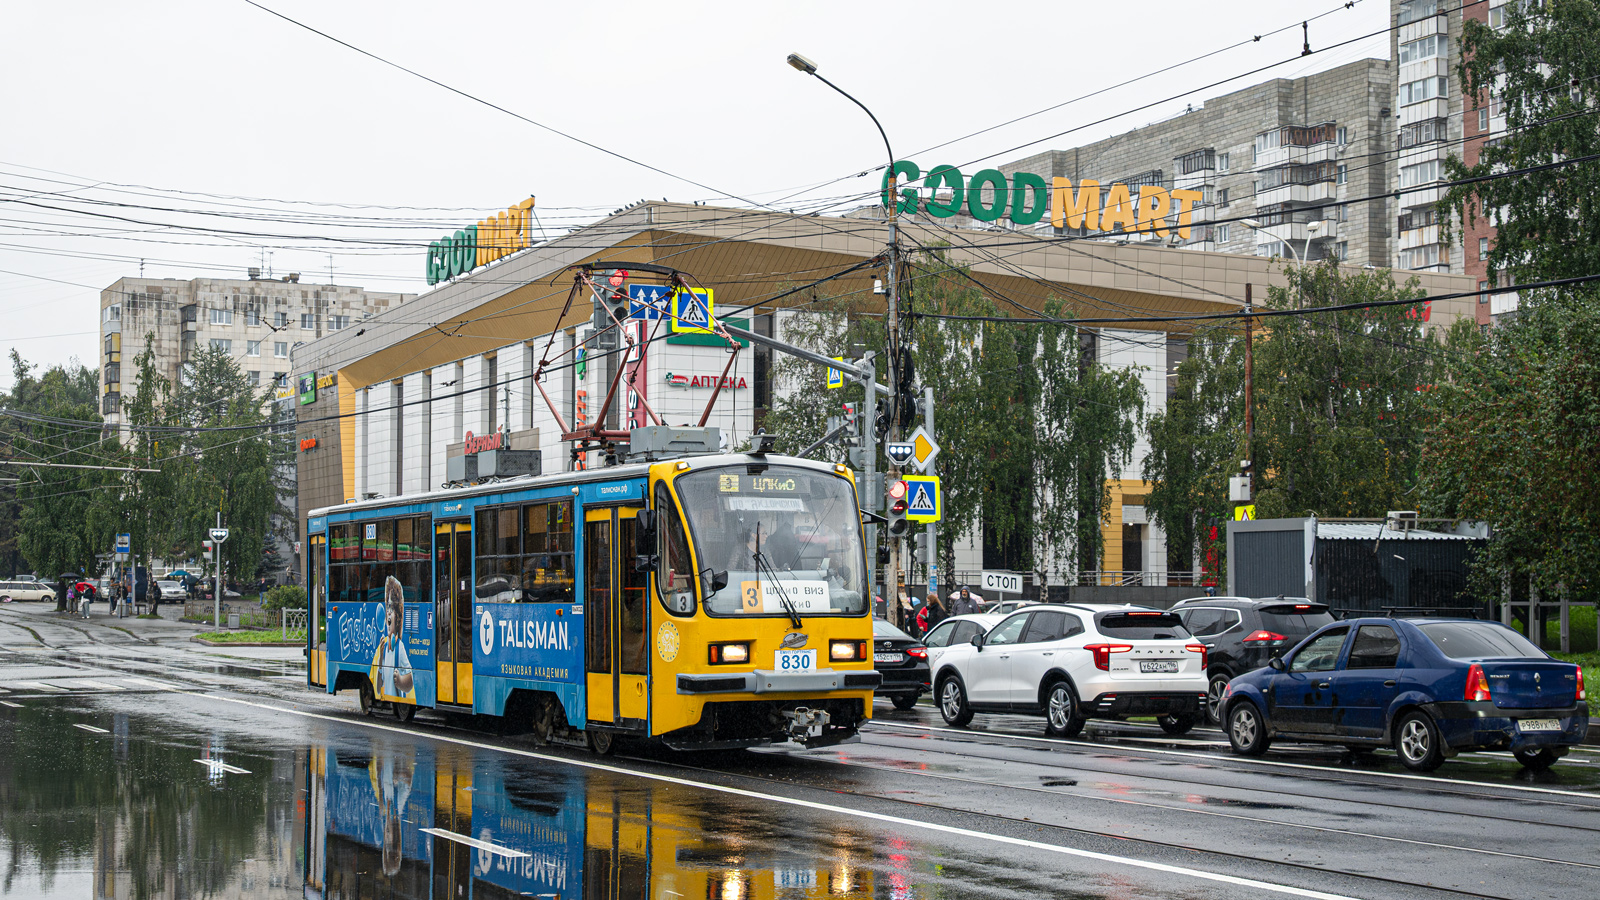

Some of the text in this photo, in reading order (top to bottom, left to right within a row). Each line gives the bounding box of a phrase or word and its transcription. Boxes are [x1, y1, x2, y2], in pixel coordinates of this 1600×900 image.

[690, 375, 748, 389] АПТЕКА
[753, 477, 796, 492] ЦПКиО
[987, 574, 1017, 590] СТОП
[746, 587, 759, 608] 3
[804, 586, 824, 595] ВИЗ
[680, 595, 687, 611] 3
[339, 607, 377, 661] English
[781, 654, 810, 670] 830
[501, 663, 569, 679] ЯЗЫКОВАЯ АКАДЕМИЯ
